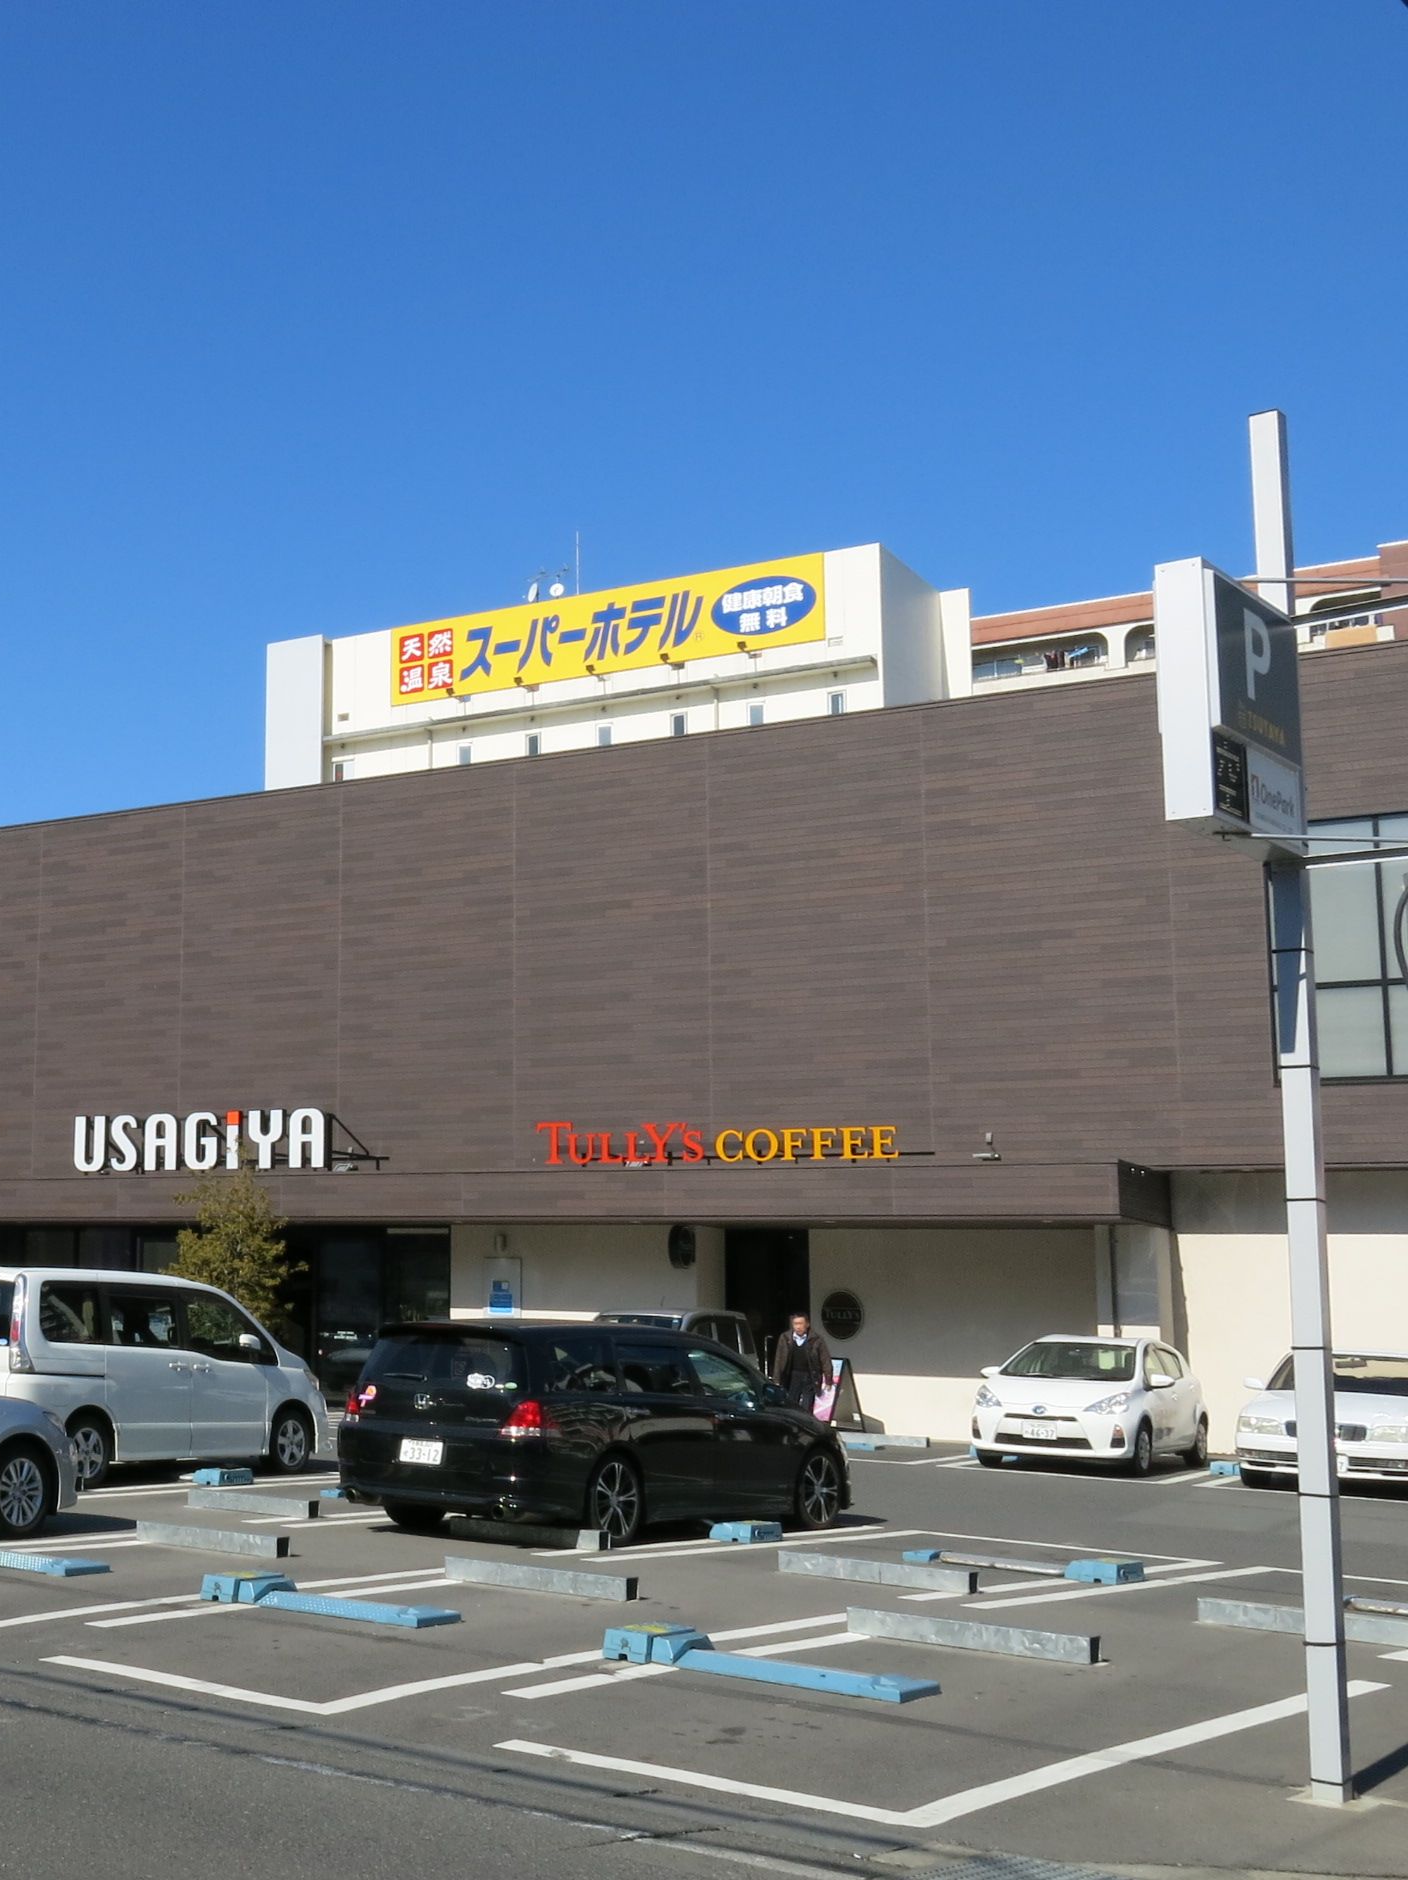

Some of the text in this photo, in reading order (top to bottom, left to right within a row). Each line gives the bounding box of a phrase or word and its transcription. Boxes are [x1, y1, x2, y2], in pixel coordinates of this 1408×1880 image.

[722, 581, 804, 614] 健康朝食
[459, 589, 704, 682] スーパーホテル
[739, 606, 788, 633] 無料
[401, 630, 453, 661] 天然
[1243, 606, 1272, 701] P
[400, 661, 453, 693] 温泉
[72, 1107, 326, 1172] USAGIYA
[714, 1125, 900, 1163] COFFEE
[408, 1447, 440, 1462] 33-12
